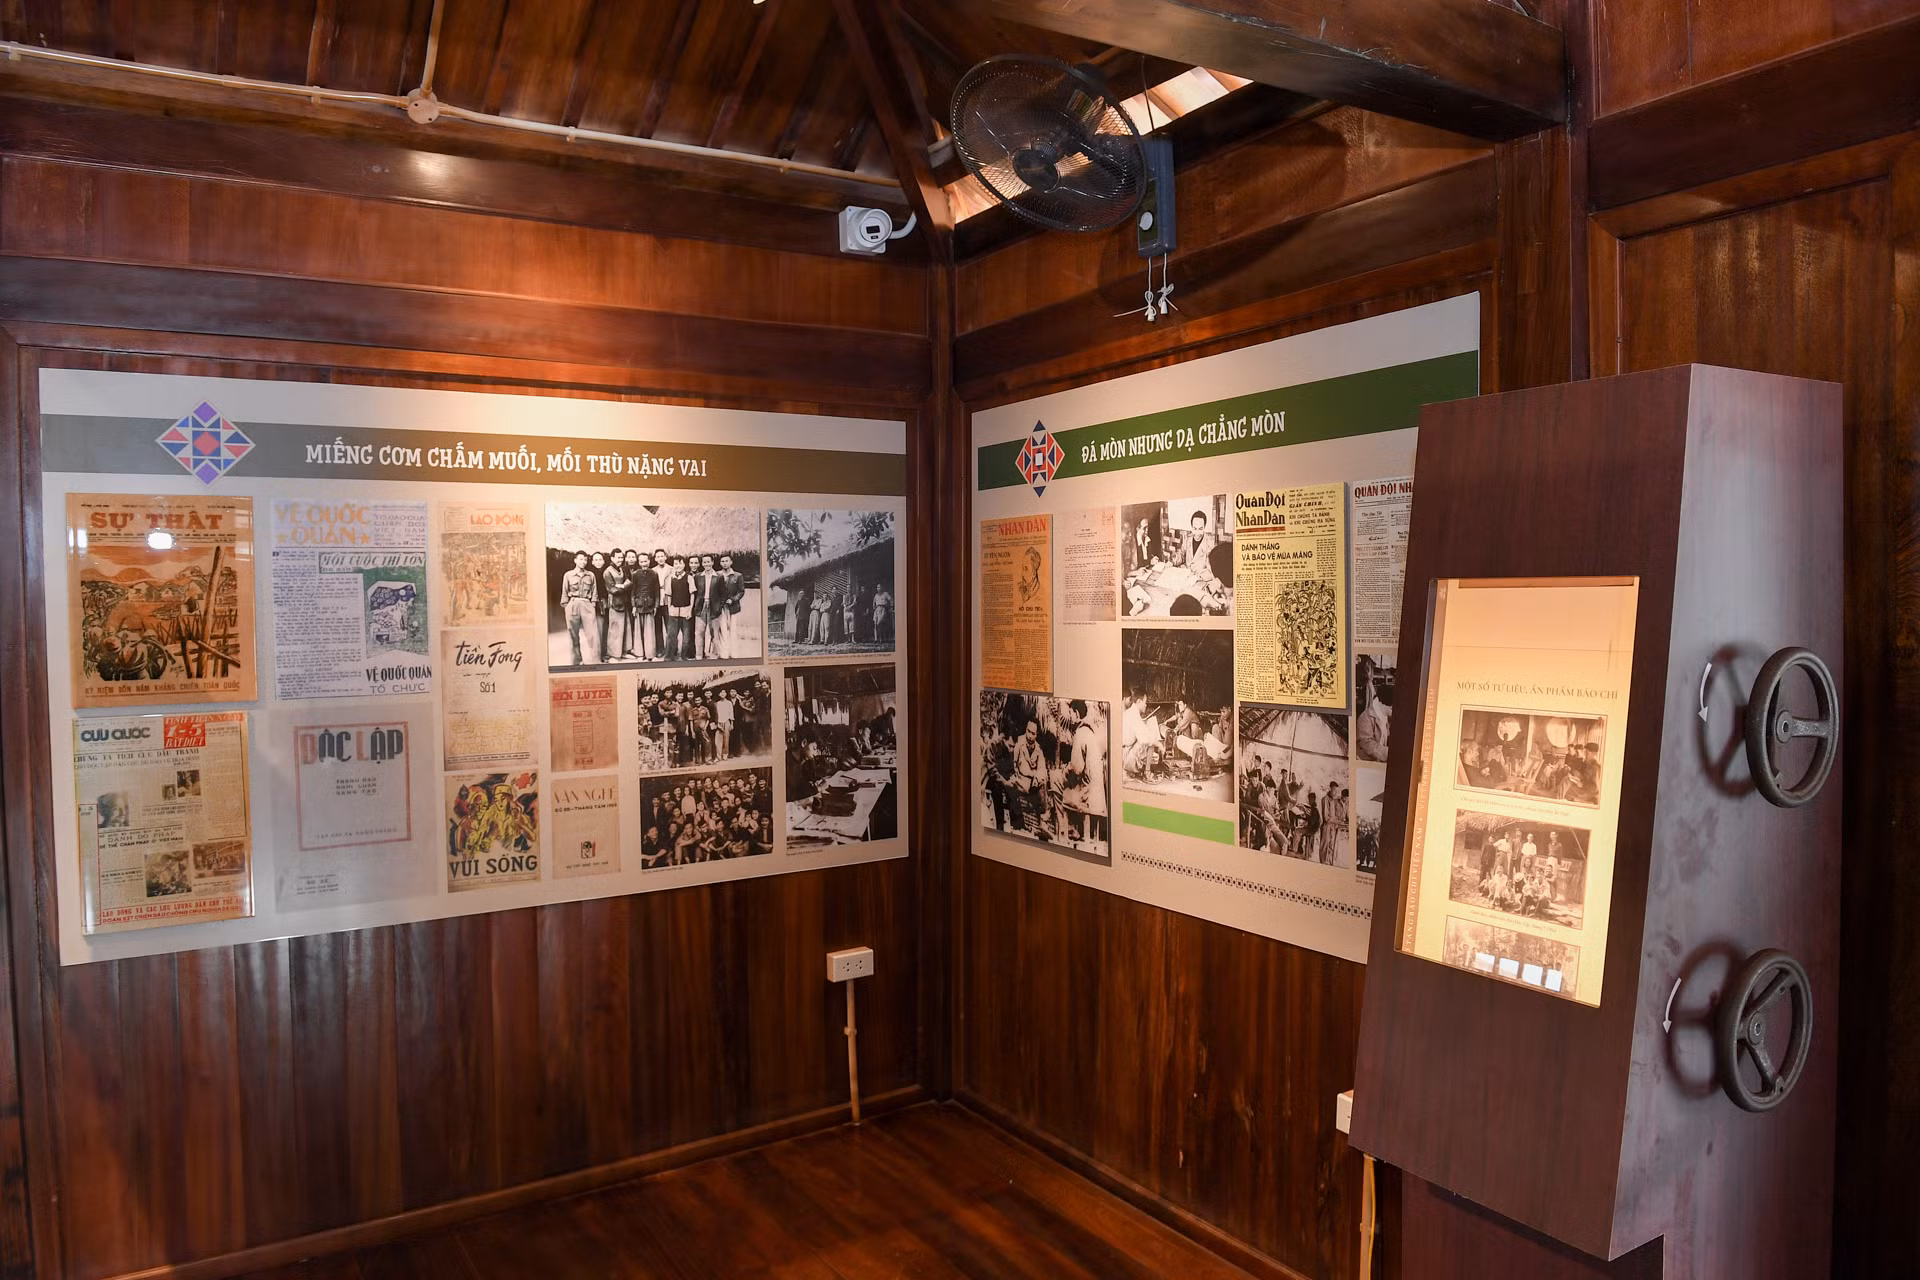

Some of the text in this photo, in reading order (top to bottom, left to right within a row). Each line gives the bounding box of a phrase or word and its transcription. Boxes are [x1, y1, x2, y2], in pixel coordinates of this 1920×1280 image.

[1081, 408, 1286, 464] ĐÁ MÒN NHƯNG DẠ CHẲNG MÒN
[305, 436, 707, 479] MIẾNG CƠM CHẤM MUỐI, MỐI THÙ NẶNG VAI
[1399, 481, 1412, 493] NH
[90, 510, 223, 533] SỰ THẬT
[1456, 680, 1477, 692] MỘT
[1478, 680, 1490, 692] SỐ
[449, 853, 538, 879] VUI SỐNG
